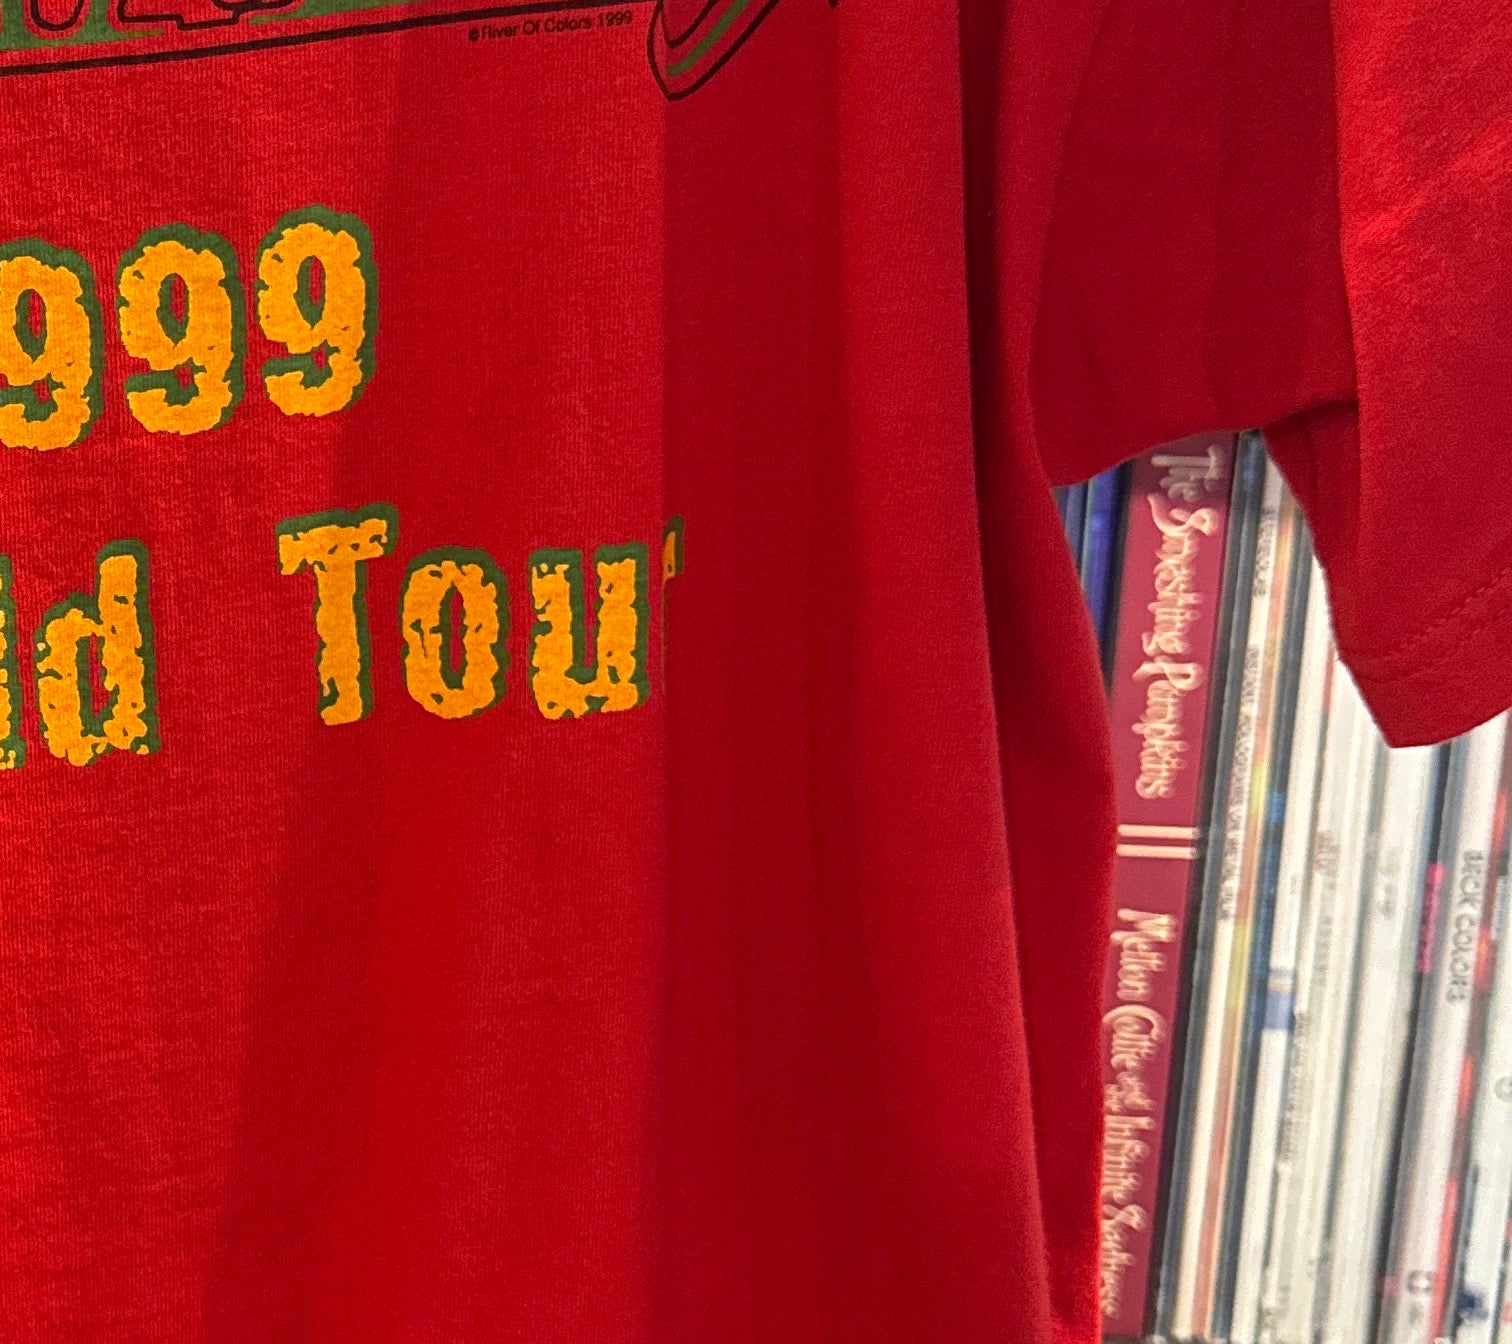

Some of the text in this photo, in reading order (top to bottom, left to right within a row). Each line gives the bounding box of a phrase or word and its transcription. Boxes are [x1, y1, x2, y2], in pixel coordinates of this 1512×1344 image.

[522, 19, 540, 35] Of
[544, 16, 592, 34] Colors
[597, 10, 633, 28] 1999
[1131, 444, 1224, 800] The Smashing Pumpkins
[1110, 908, 1177, 1002] Mellon
